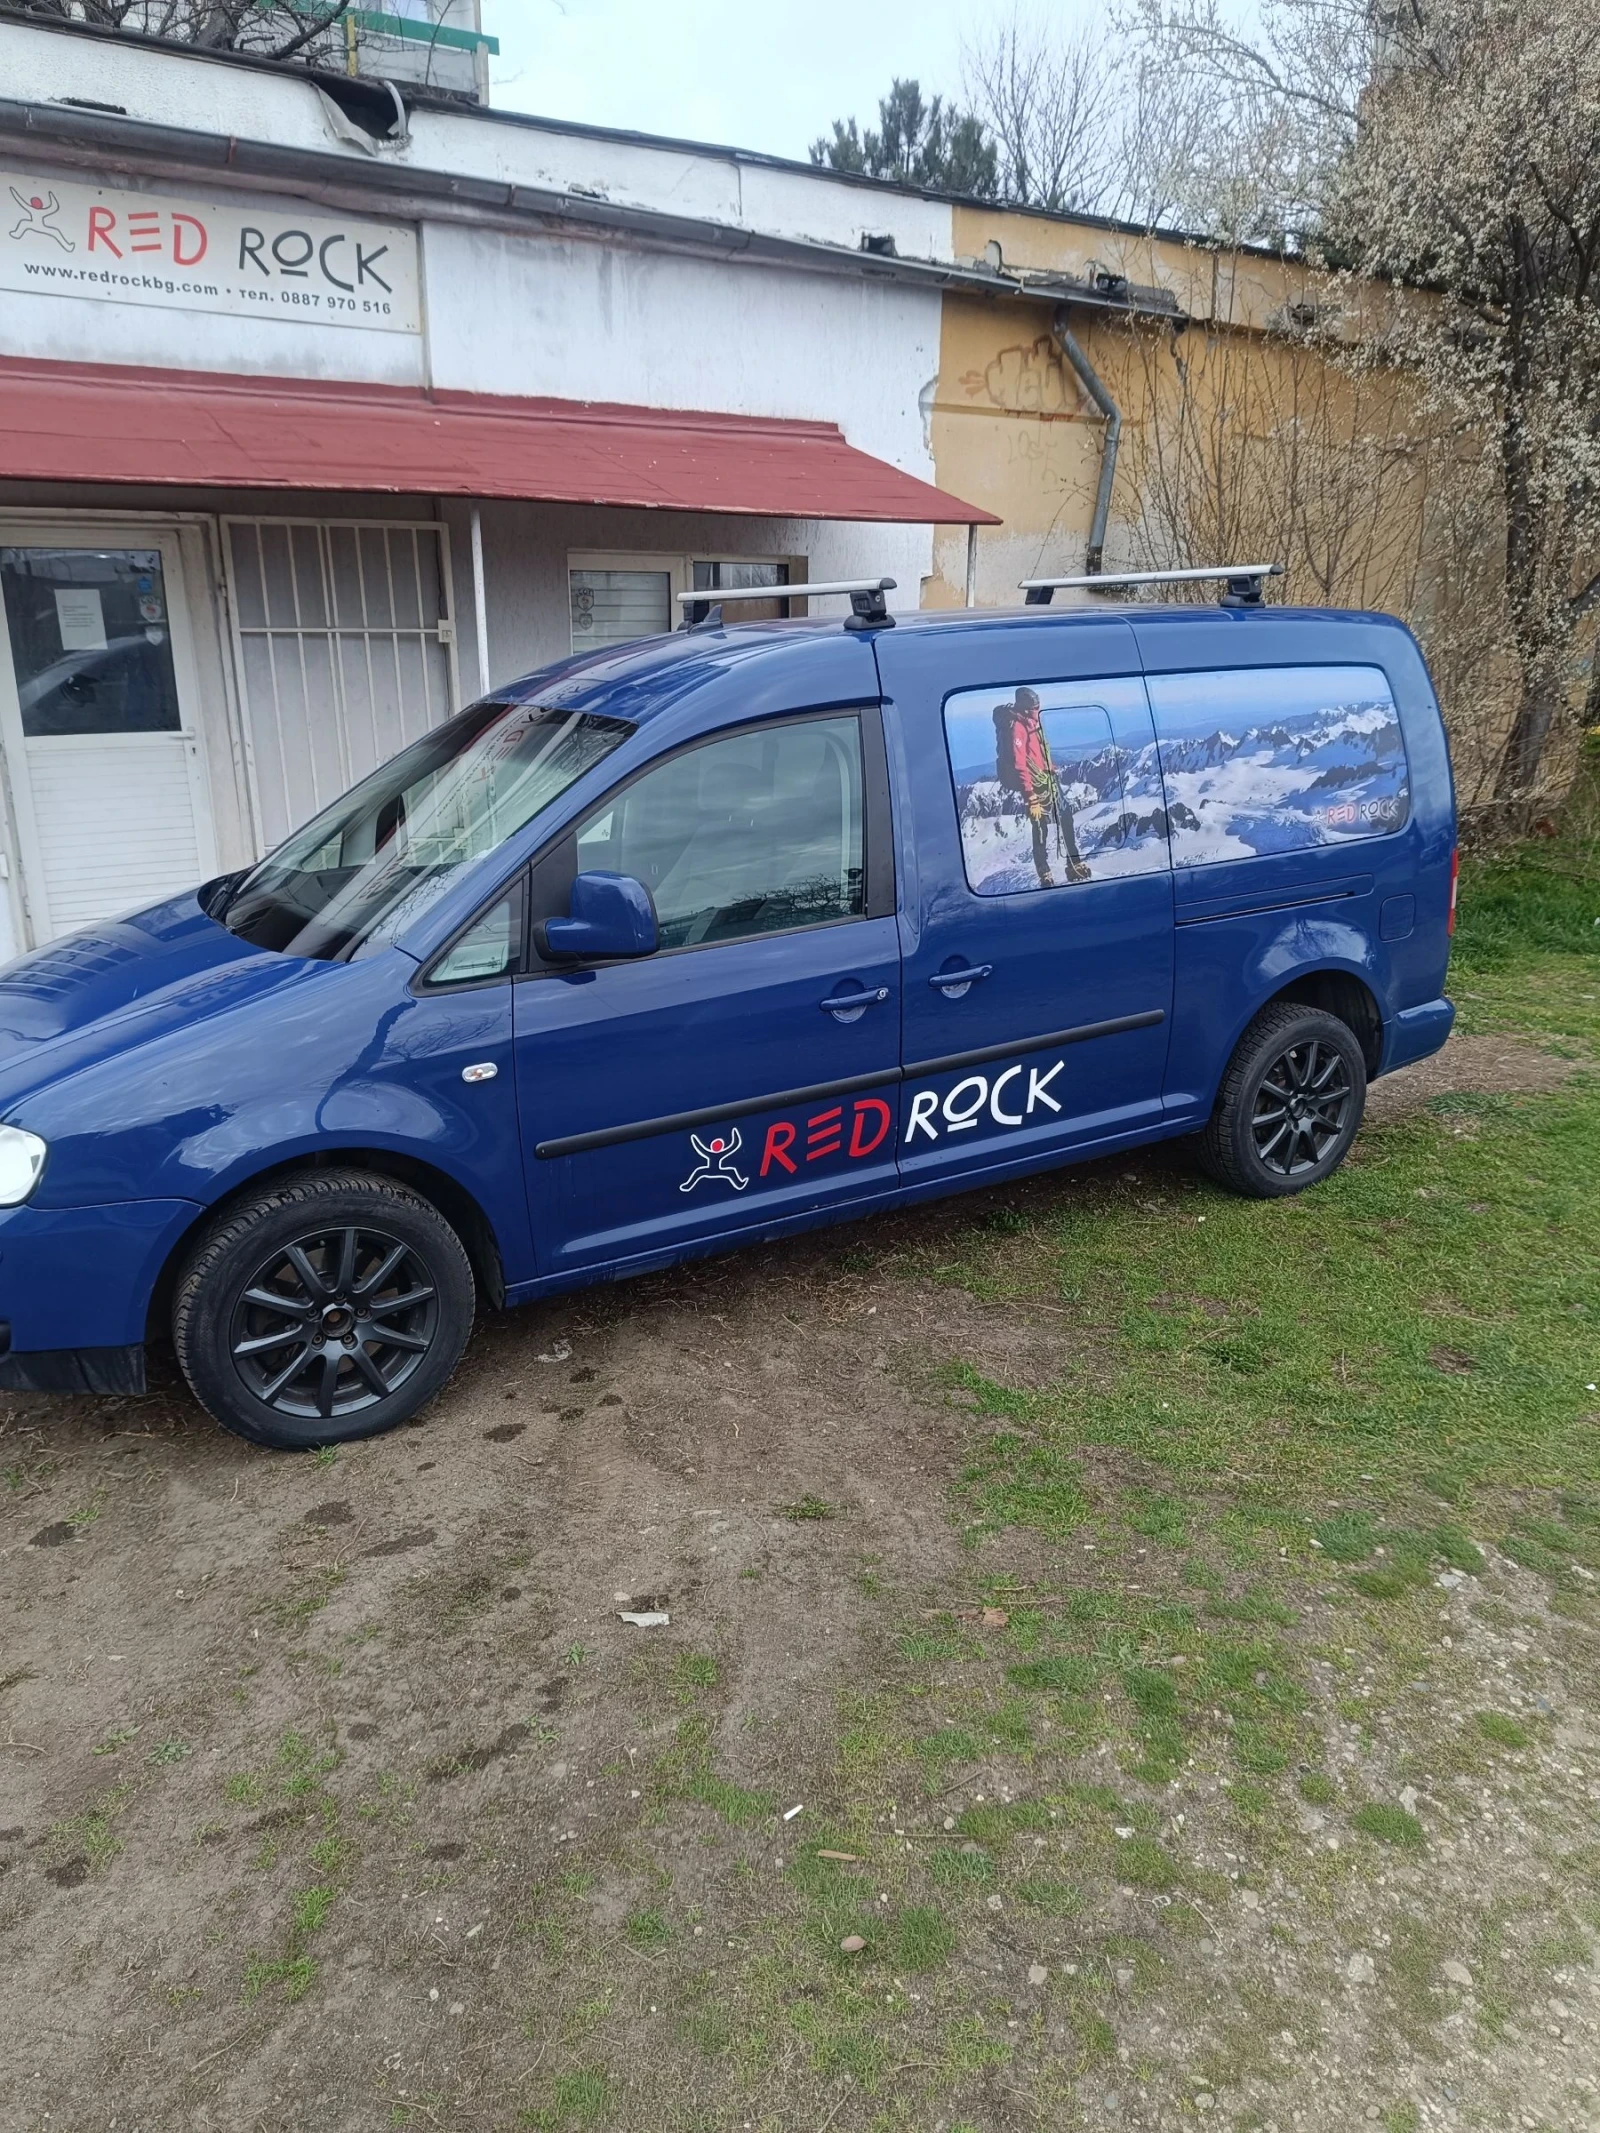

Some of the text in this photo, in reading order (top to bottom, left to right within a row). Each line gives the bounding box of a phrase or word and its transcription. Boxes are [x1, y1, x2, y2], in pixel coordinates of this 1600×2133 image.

[87, 206, 393, 294] RED ROCK
[25, 263, 218, 295] www.redrockbg.com
[281, 290, 320, 308] 0887
[327, 295, 356, 312] 970
[363, 300, 392, 315] 516
[1327, 799, 1398, 824] RED ROCK
[759, 1060, 1065, 1177] RED ROCK
